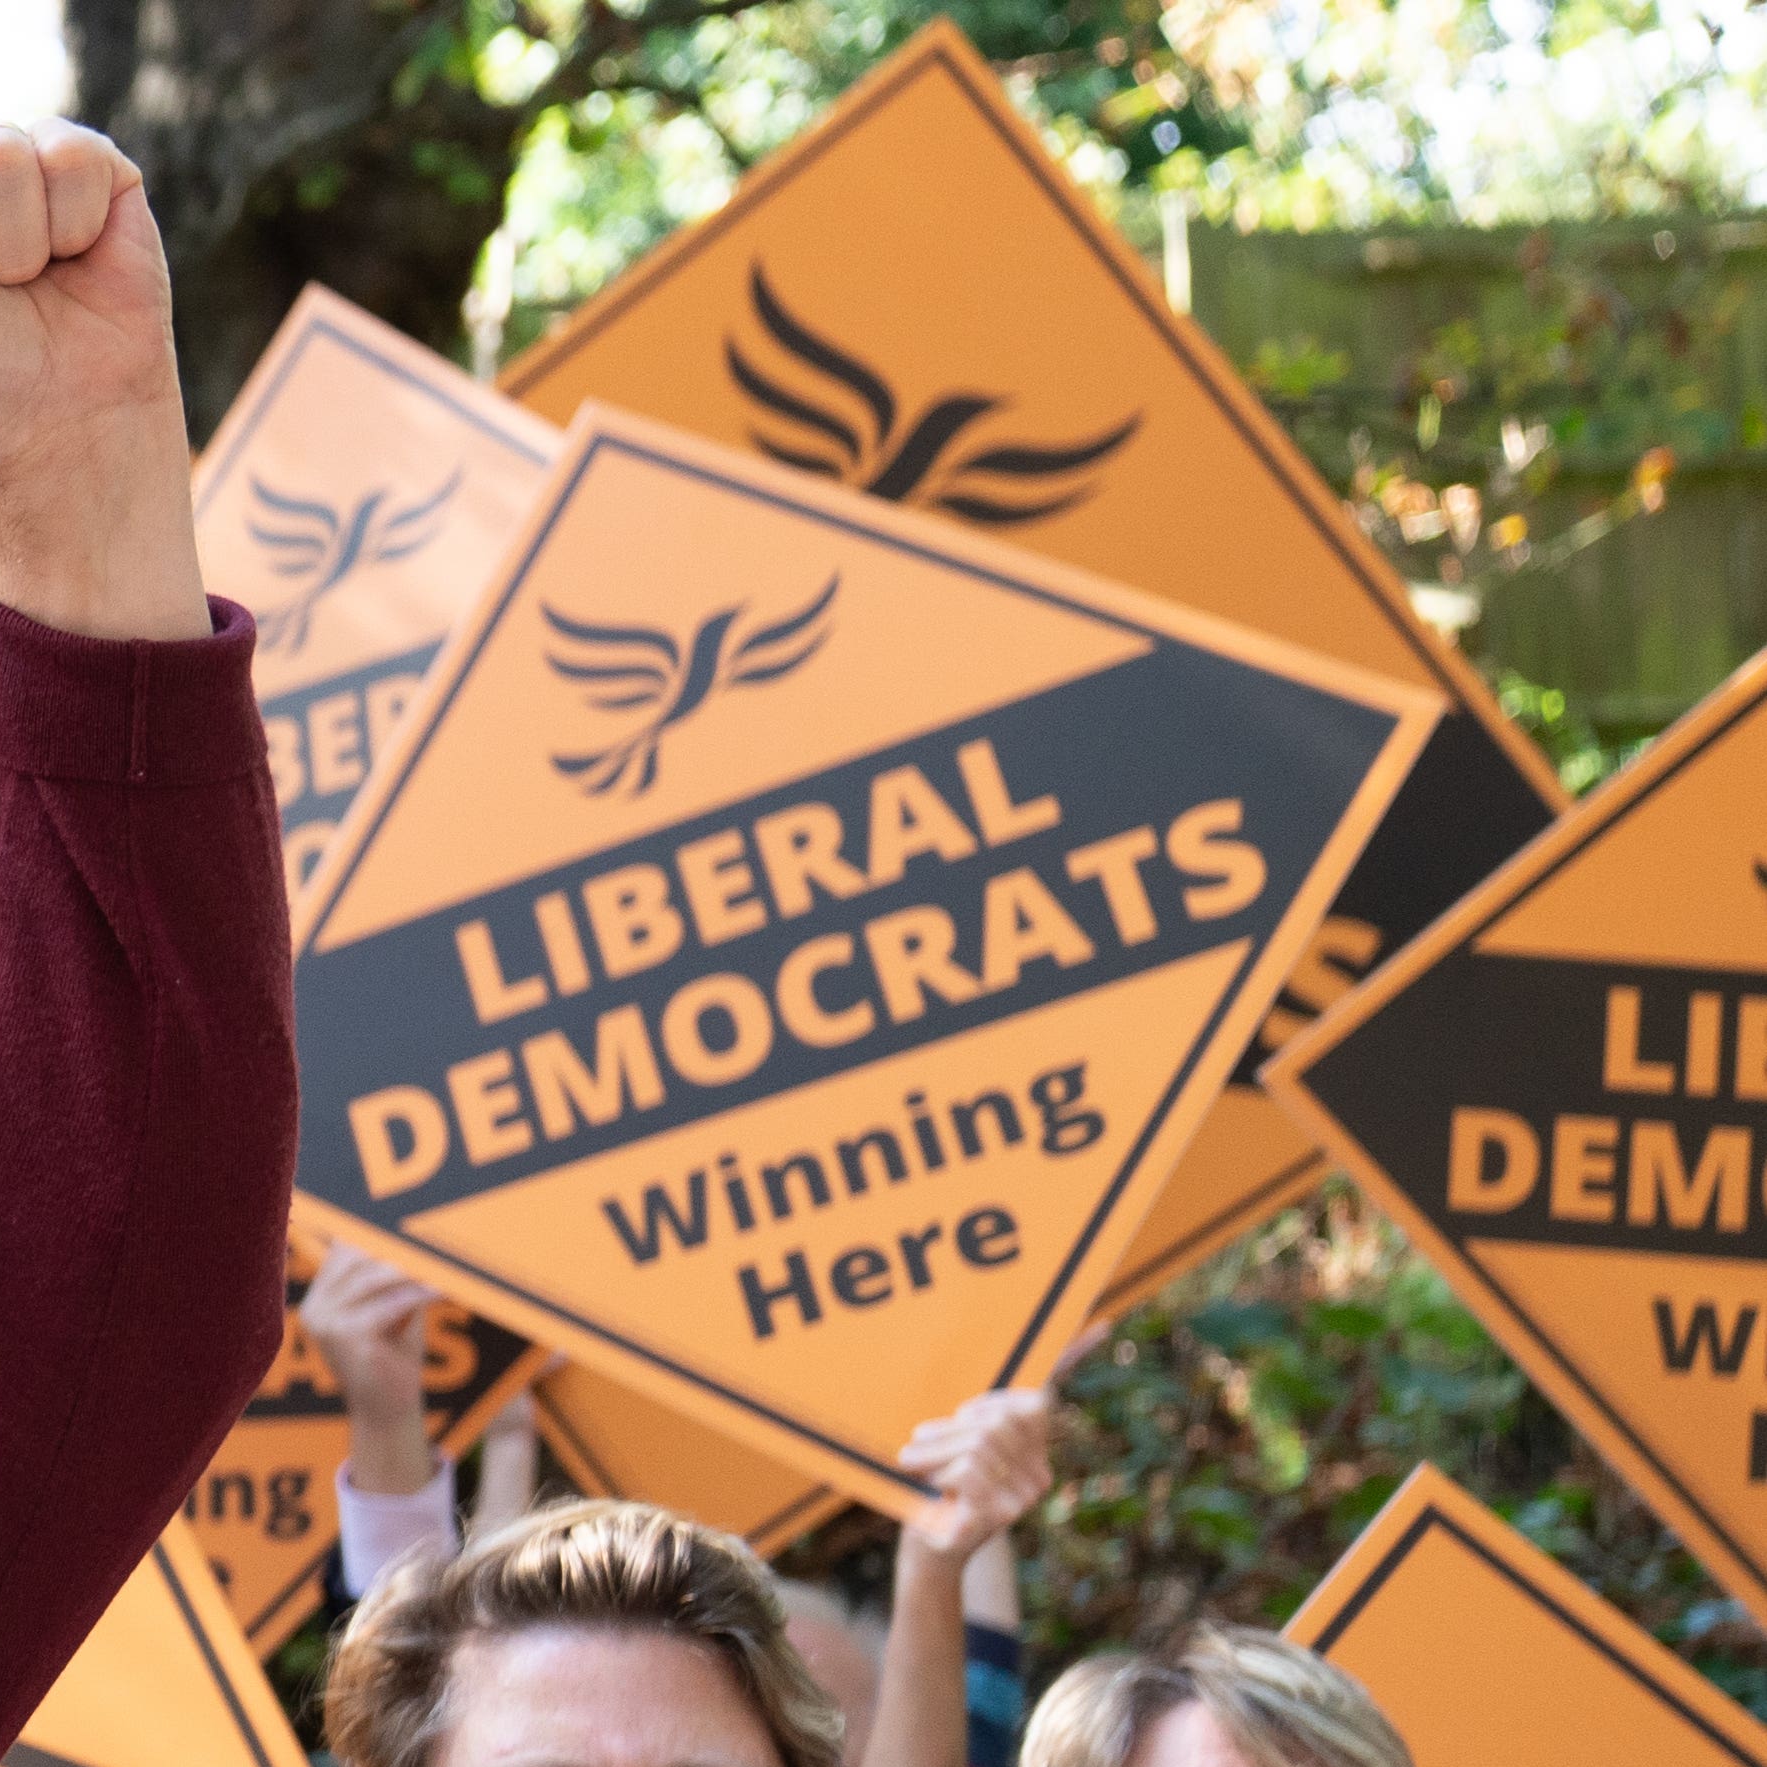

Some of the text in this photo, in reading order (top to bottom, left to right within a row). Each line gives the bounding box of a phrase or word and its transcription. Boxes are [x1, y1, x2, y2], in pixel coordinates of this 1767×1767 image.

[455, 736, 1062, 1025] LIBERAL
[348, 799, 1267, 1199] DEMOCRATS
[601, 1059, 1106, 1267] Winning
[1447, 1106, 1767, 1233] DEM
[736, 1201, 1022, 1340] Here
